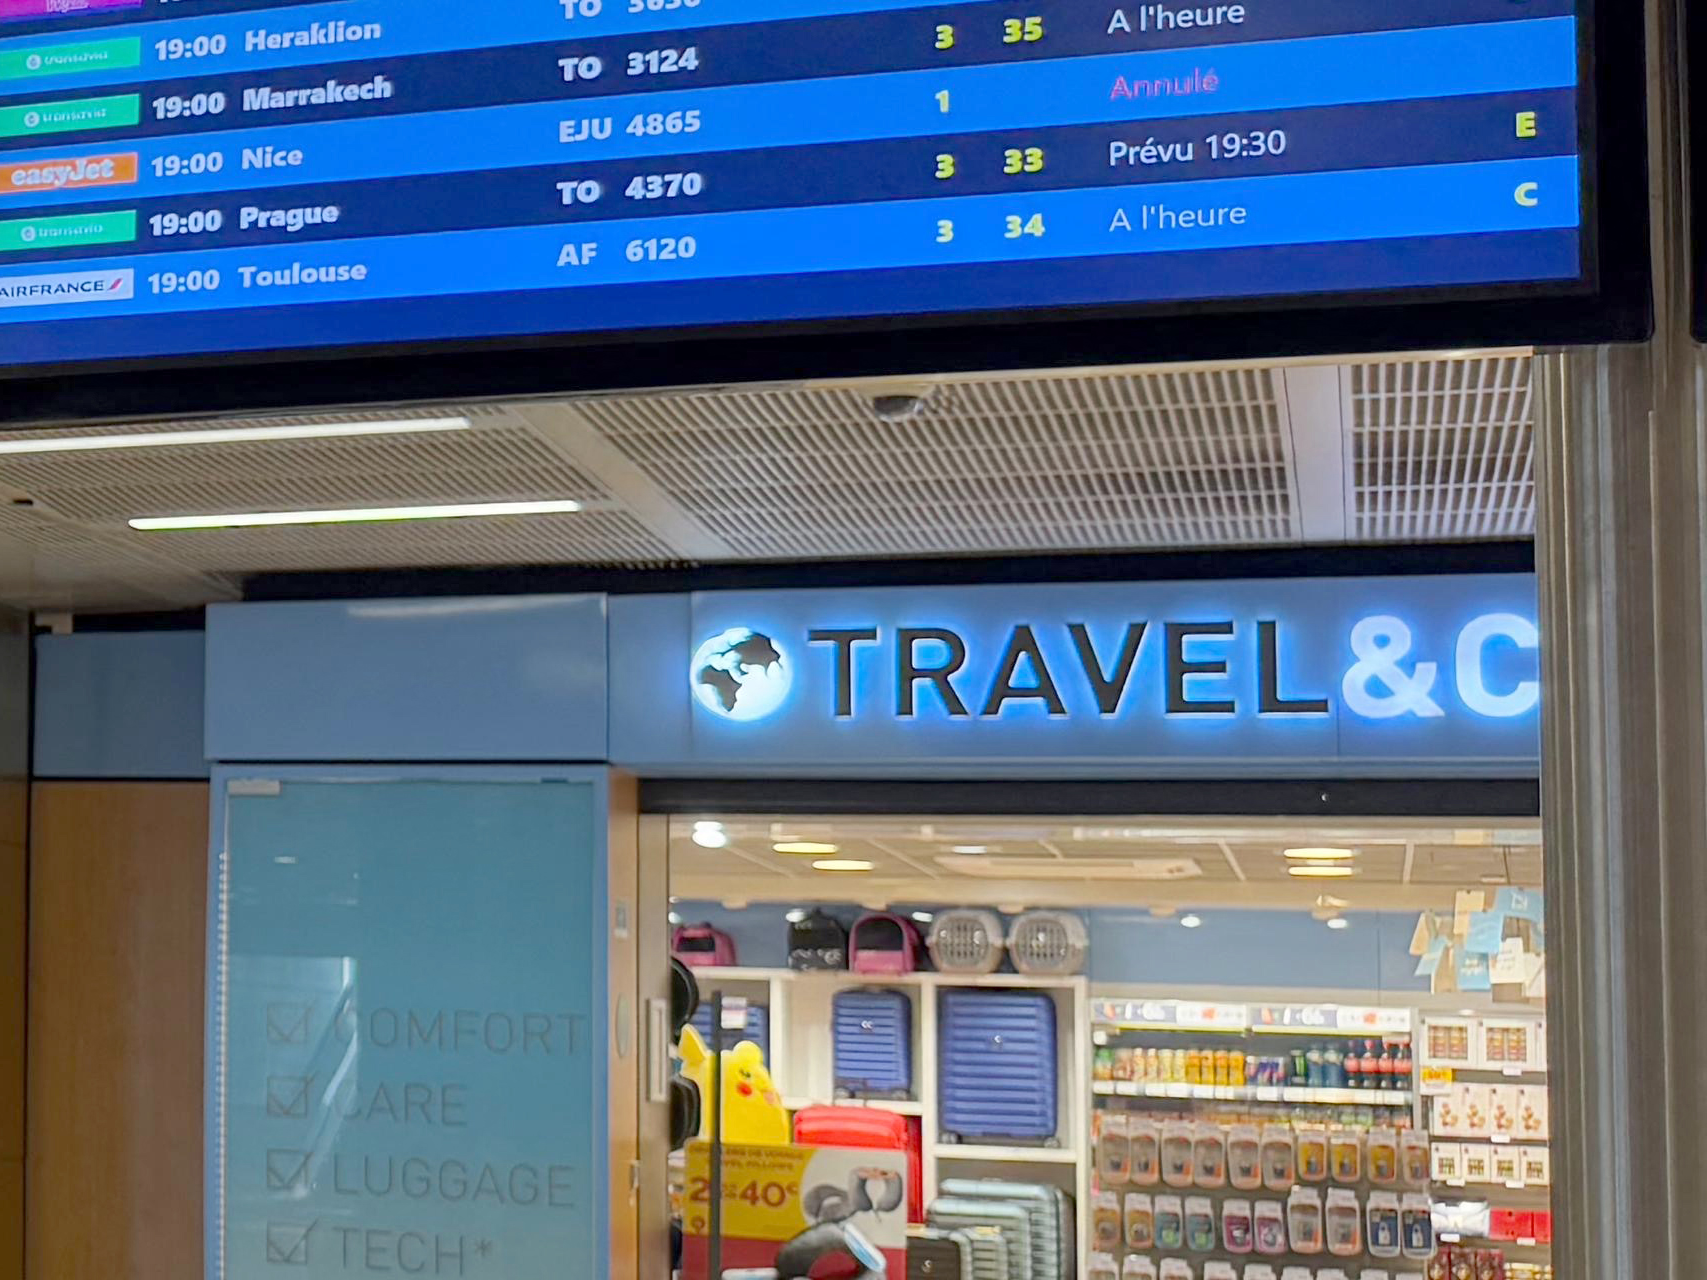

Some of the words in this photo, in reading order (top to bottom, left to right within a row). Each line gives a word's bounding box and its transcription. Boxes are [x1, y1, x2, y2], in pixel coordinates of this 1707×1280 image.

[149, 209, 222, 236] 19:00
[240, 205, 340, 232] Prague
[556, 180, 601, 204] TO
[625, 172, 703, 199] 4370
[935, 153, 956, 178] 3
[1004, 147, 1044, 173] 33
[1110, 136, 1193, 166] Prévu
[1206, 130, 1286, 159] 19:30
[1516, 111, 1536, 137] E
[334, 1007, 587, 1056] COMFORT
[333, 1154, 576, 1208] LUGGAGE
